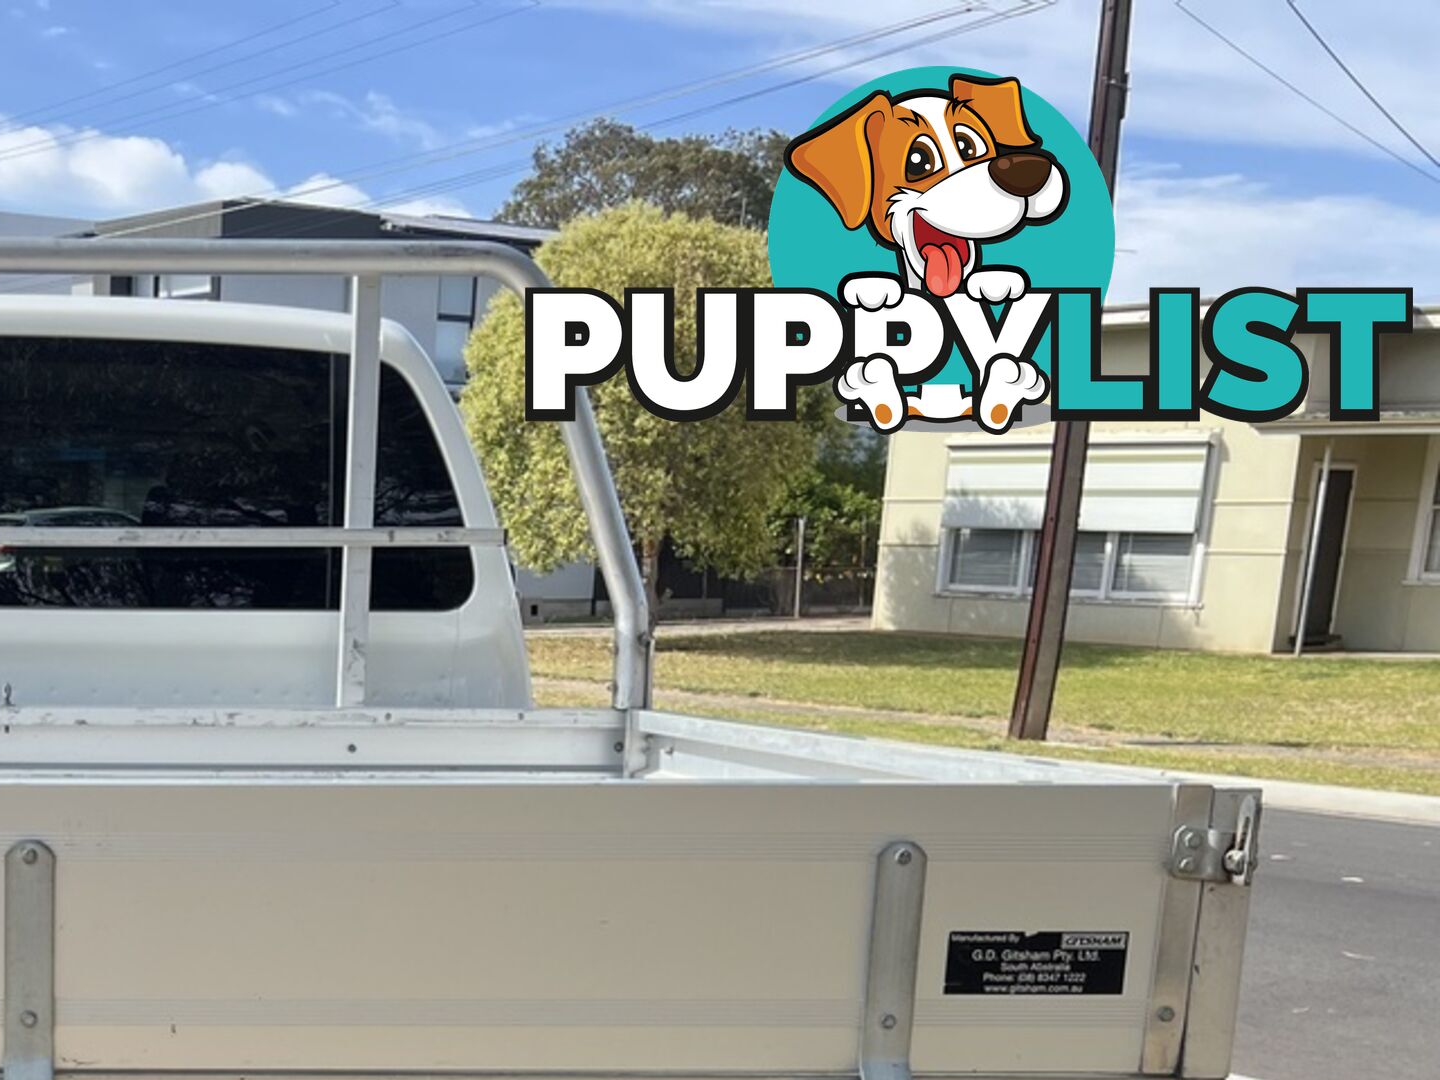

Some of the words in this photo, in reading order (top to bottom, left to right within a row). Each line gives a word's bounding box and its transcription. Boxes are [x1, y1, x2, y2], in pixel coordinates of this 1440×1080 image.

[971, 949, 998, 962] G.D.
[1001, 949, 1051, 962] Gitsham
[1077, 949, 1101, 962] Ltd.
[1000, 962, 1028, 972] South
[983, 984, 1084, 995] www.gitsham.com.au
